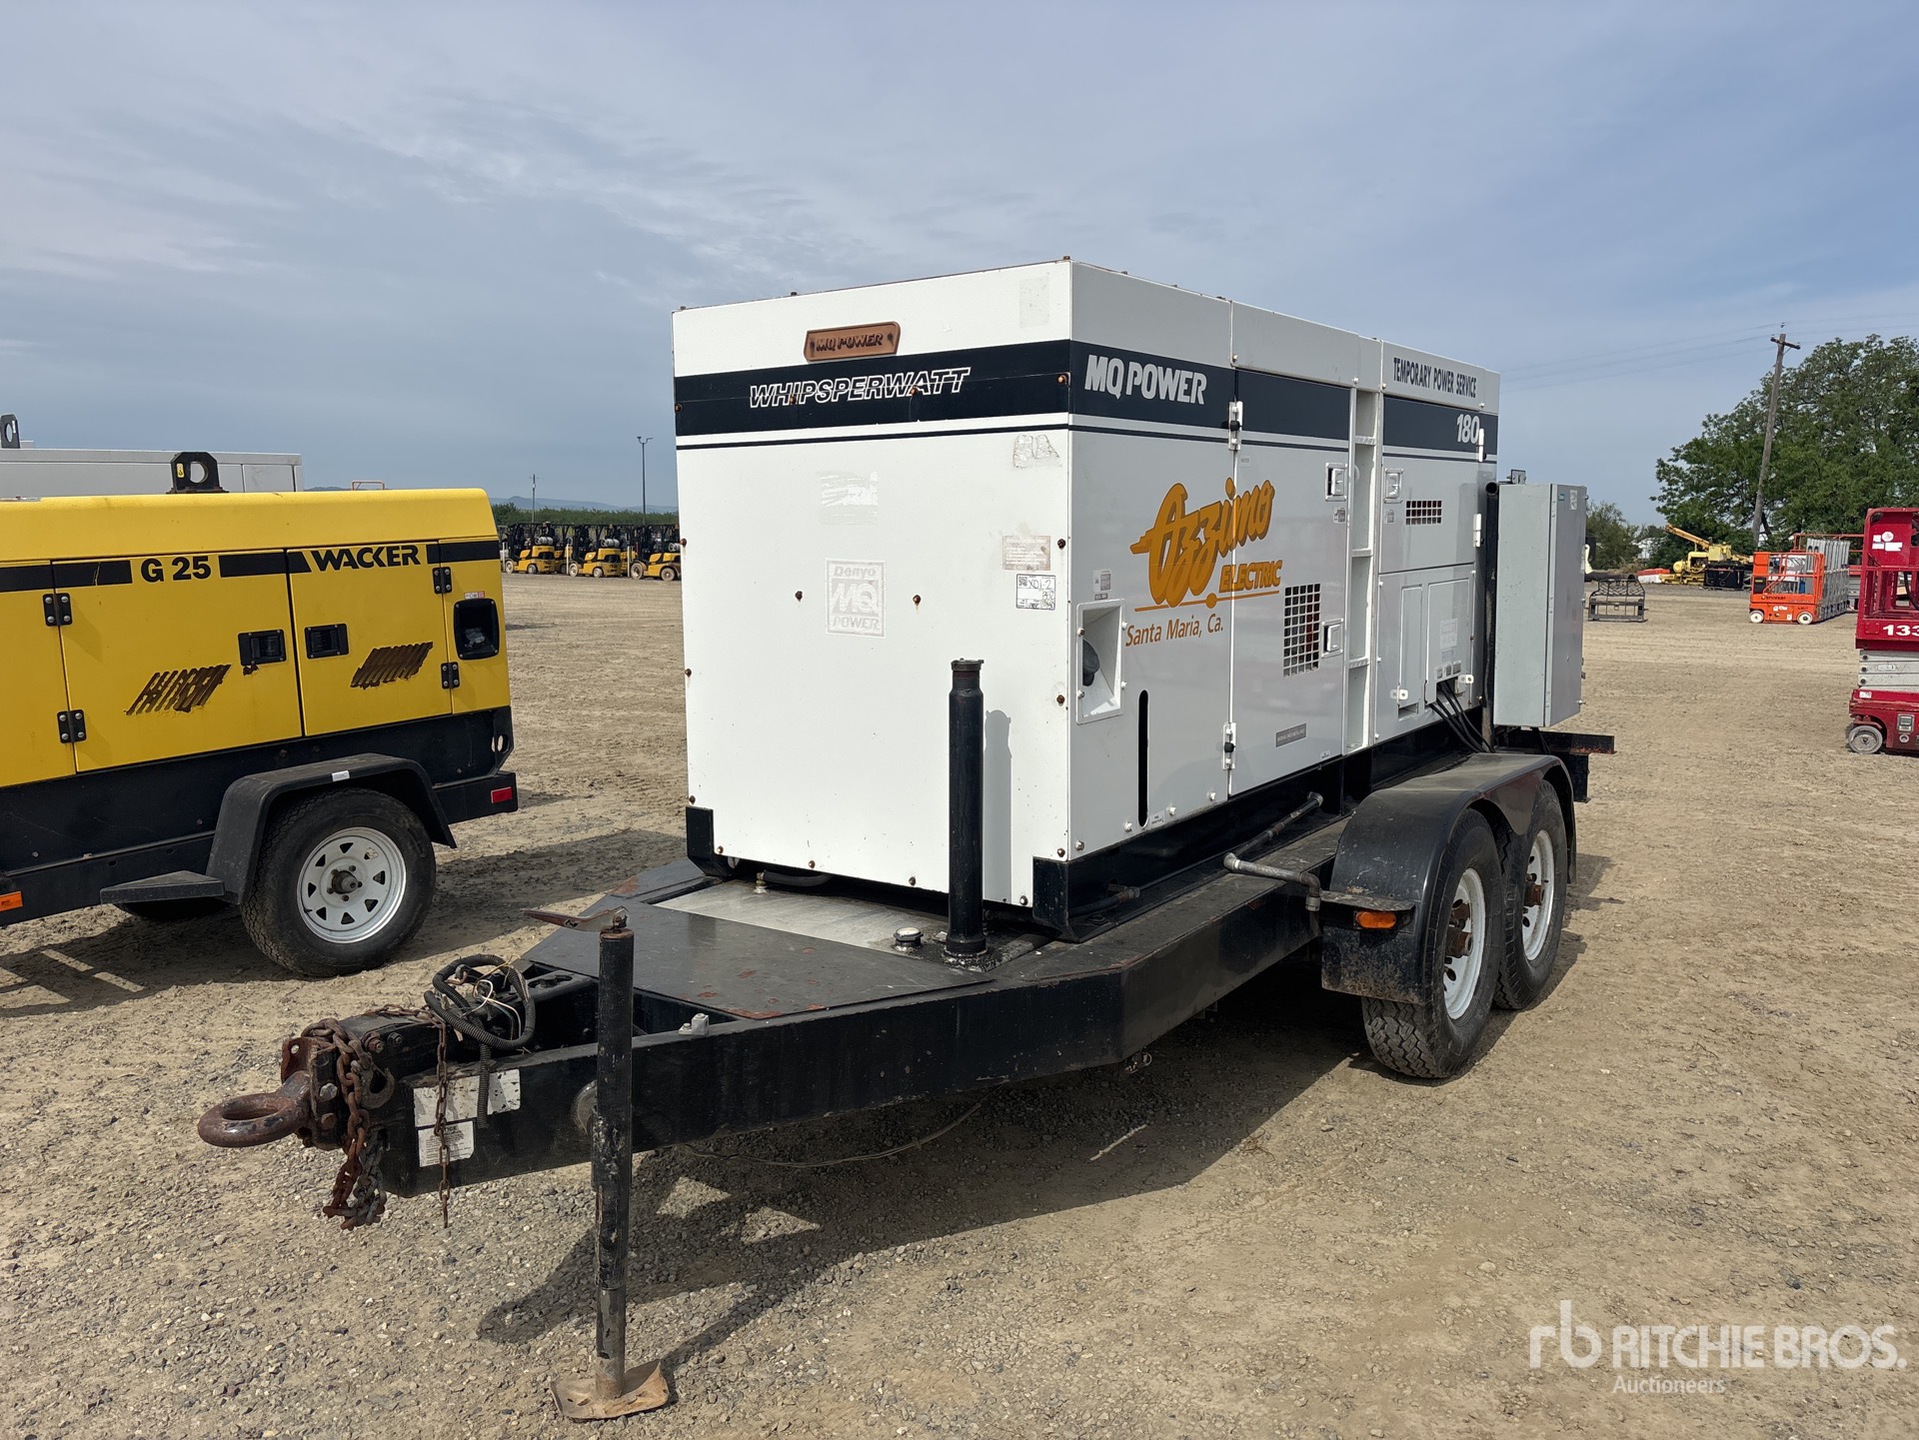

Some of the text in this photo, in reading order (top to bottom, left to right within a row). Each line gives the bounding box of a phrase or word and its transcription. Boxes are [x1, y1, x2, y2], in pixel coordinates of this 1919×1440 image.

[816, 333, 884, 351] MQ POWER
[750, 367, 971, 408] WHIPSPERWATT
[1084, 354, 1208, 405] MQ POWER
[1393, 357, 1477, 398] TEMPORARY POWER SERVICE
[1456, 413, 1480, 444] 180
[140, 555, 212, 583] G 25
[311, 545, 420, 572] WACKER
[833, 565, 877, 579] Denyo
[1218, 559, 1284, 593] ELECTRIC
[832, 616, 881, 630] POWER
[1125, 613, 1224, 647] Santa Maria, Ca.
